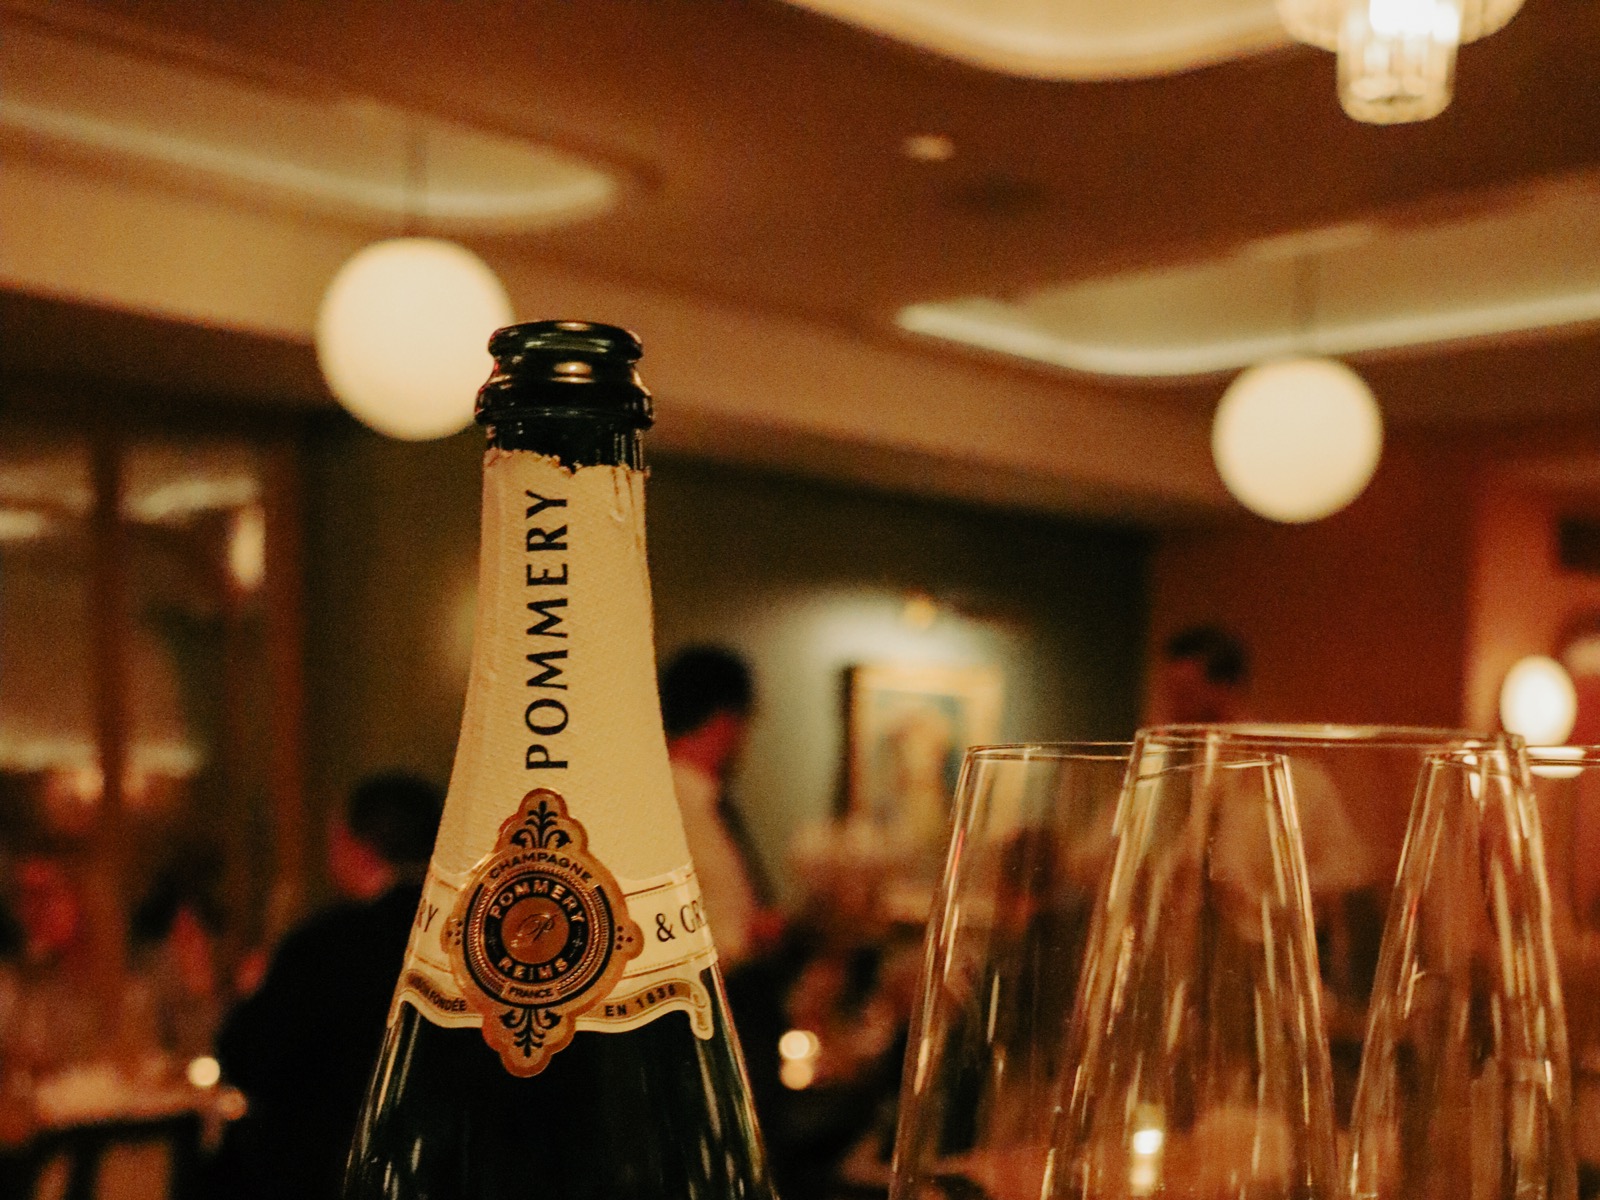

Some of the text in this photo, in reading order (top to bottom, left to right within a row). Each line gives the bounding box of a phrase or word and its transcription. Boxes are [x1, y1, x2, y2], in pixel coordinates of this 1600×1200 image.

[525, 489, 569, 770] POMMERY
[489, 852, 592, 883] CHAMPAGNE
[490, 880, 585, 920] POMMERY
[656, 913, 675, 942] &
[498, 957, 568, 980] REIMS
[509, 986, 554, 999] FRANCE
[605, 1005, 627, 1017] EN
